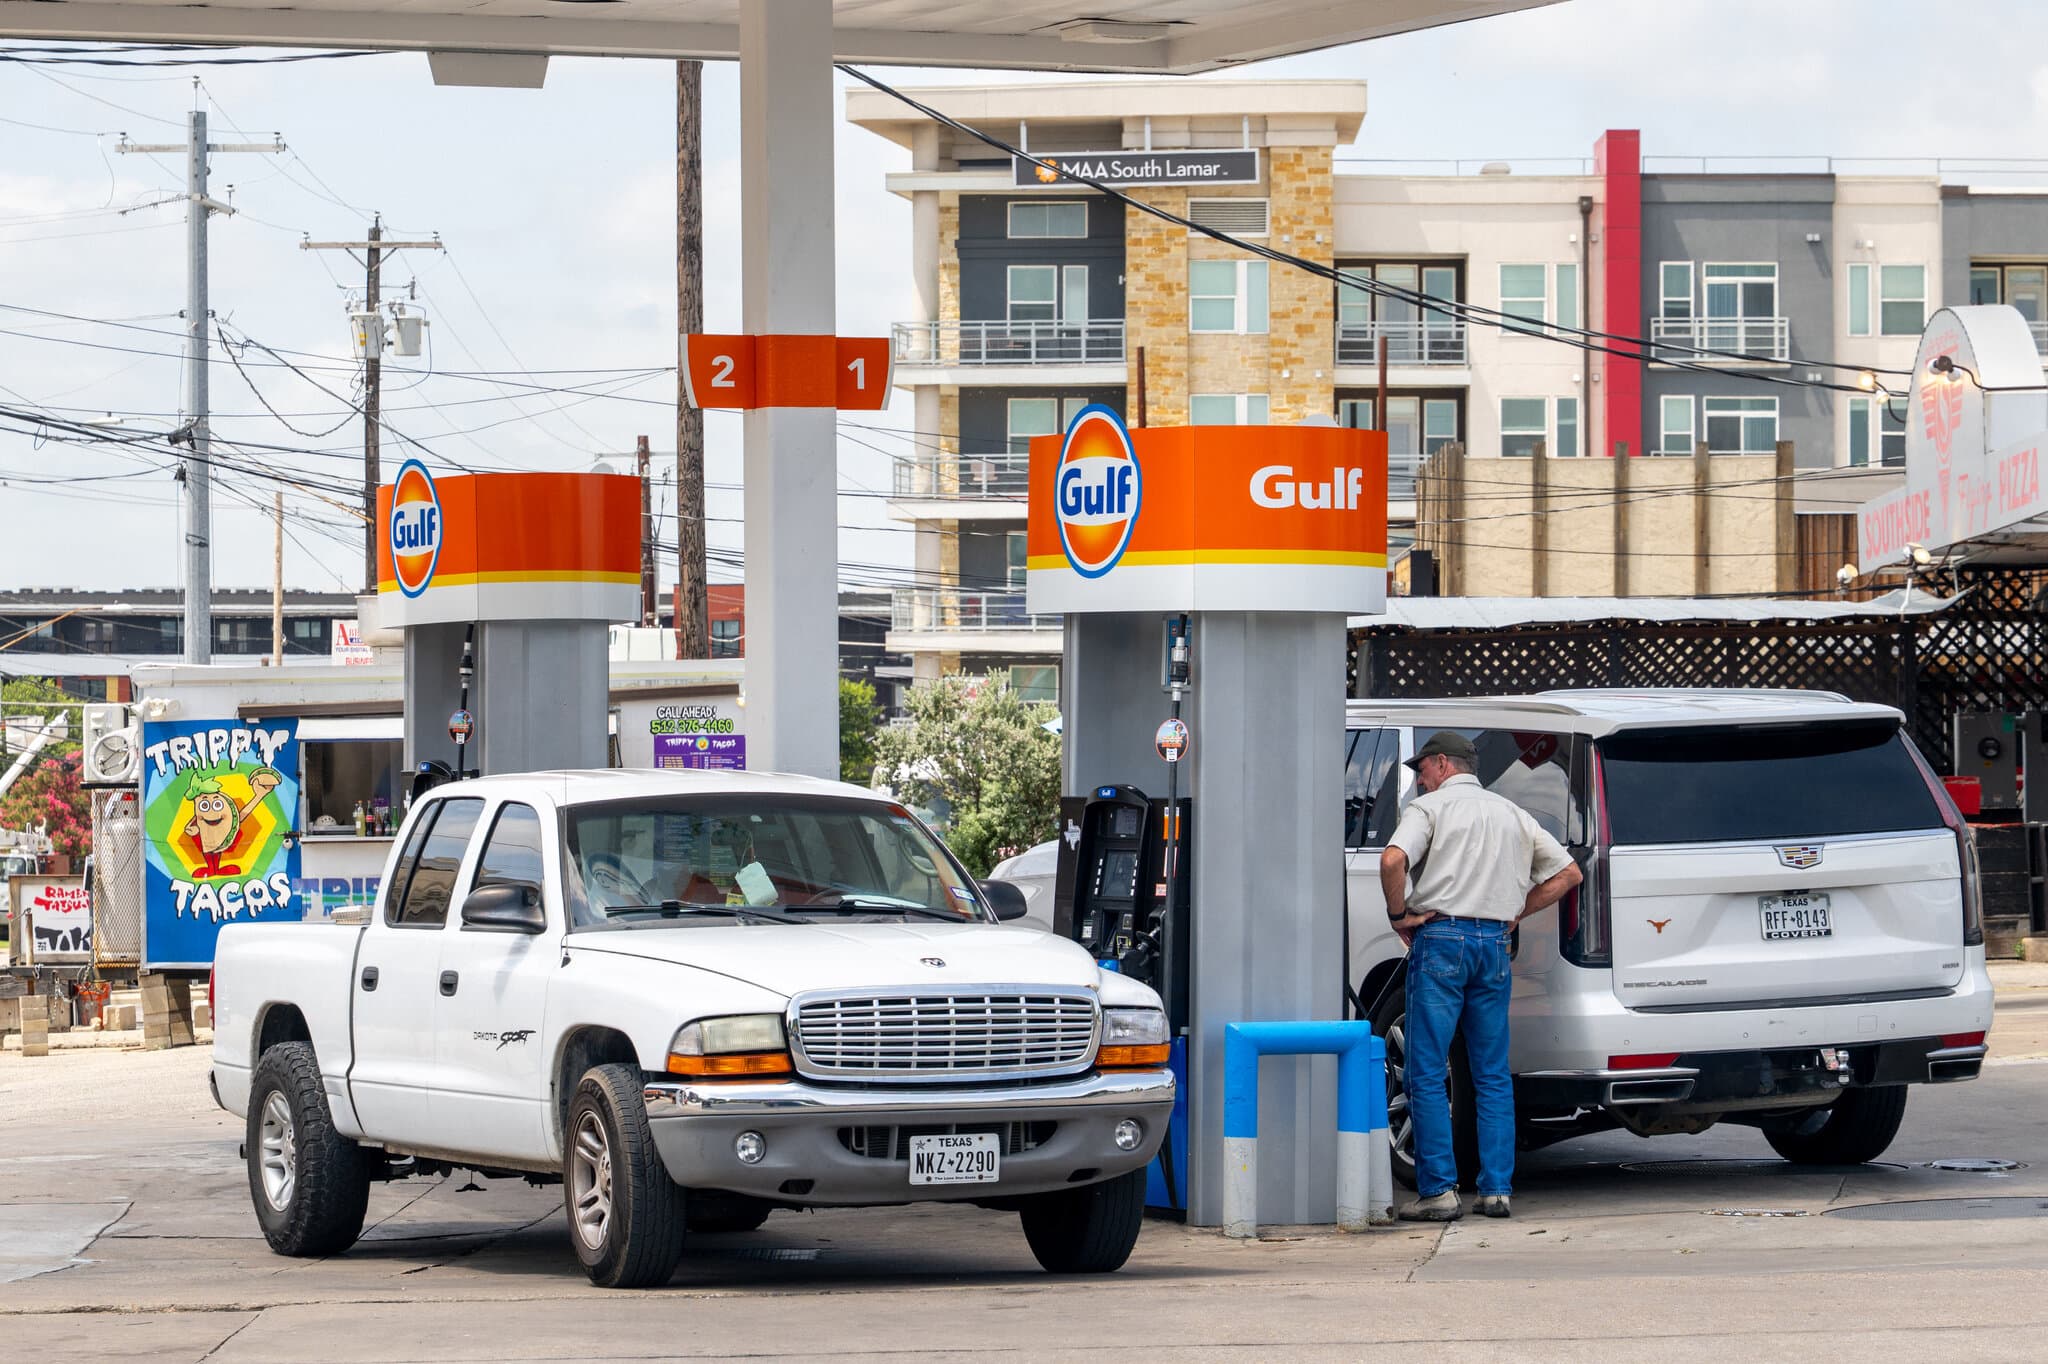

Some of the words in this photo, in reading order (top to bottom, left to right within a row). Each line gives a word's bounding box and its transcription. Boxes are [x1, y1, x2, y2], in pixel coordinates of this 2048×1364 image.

[1062, 160, 1109, 179] MAA
[1110, 160, 1163, 178] South
[1166, 159, 1221, 177] Lamar
[711, 355, 736, 388] 2
[847, 357, 865, 390] 1
[1060, 465, 1132, 517] Gulf
[1249, 465, 1363, 510] Gulf
[1864, 488, 1931, 561] SOUTHSIDE
[1999, 447, 2040, 515] PIZZA
[392, 507, 436, 549] Gulf
[657, 706, 681, 719] CALL
[682, 705, 717, 719] AHEAD!
[650, 719, 675, 734] 512
[677, 718, 734, 734] 376-4460
[145, 728, 290, 777] TRIPPY
[665, 737, 695, 748] TRIPPY
[712, 739, 736, 749] TACOS
[170, 872, 292, 924] TACOS
[1782, 898, 1809, 908] TEXAS
[1771, 930, 1827, 939] COVERT
[1623, 979, 1708, 988] ESCALADE
[473, 1031, 498, 1041] DAKOTA
[938, 1137, 972, 1148] TEXAS
